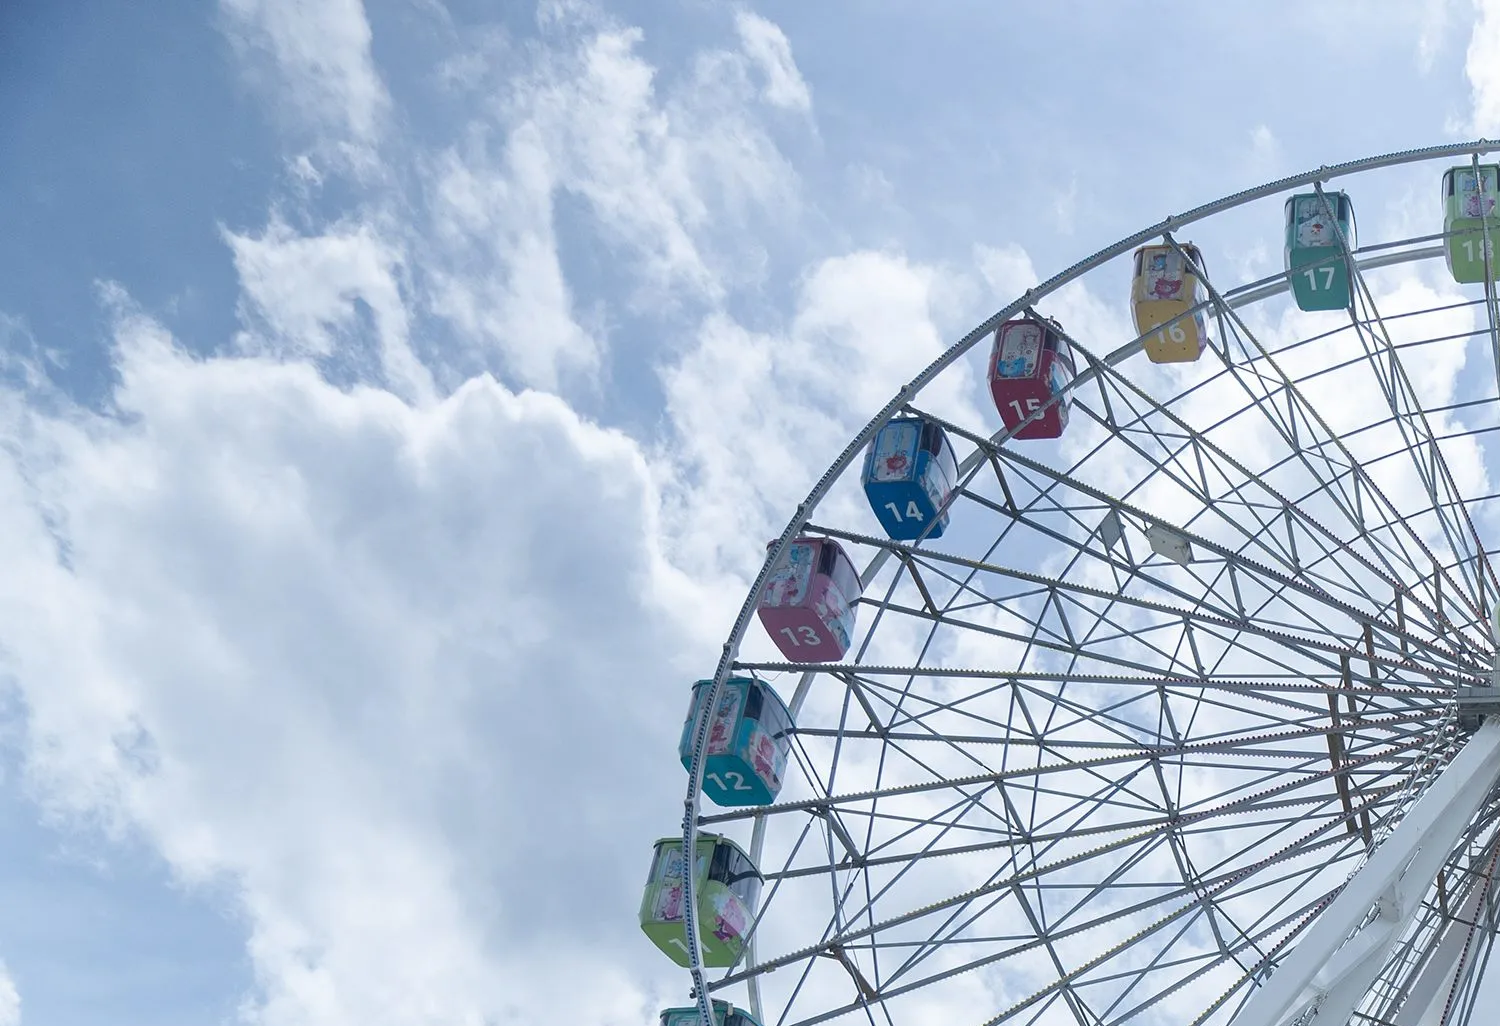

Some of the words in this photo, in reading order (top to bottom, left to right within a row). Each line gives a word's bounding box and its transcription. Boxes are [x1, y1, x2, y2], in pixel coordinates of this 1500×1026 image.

[1304, 268, 1336, 291] 17
[1153, 323, 1186, 344] 16
[1009, 399, 1045, 421] 15
[885, 500, 923, 522] 14
[780, 625, 820, 647] 13
[707, 772, 752, 791] 12
